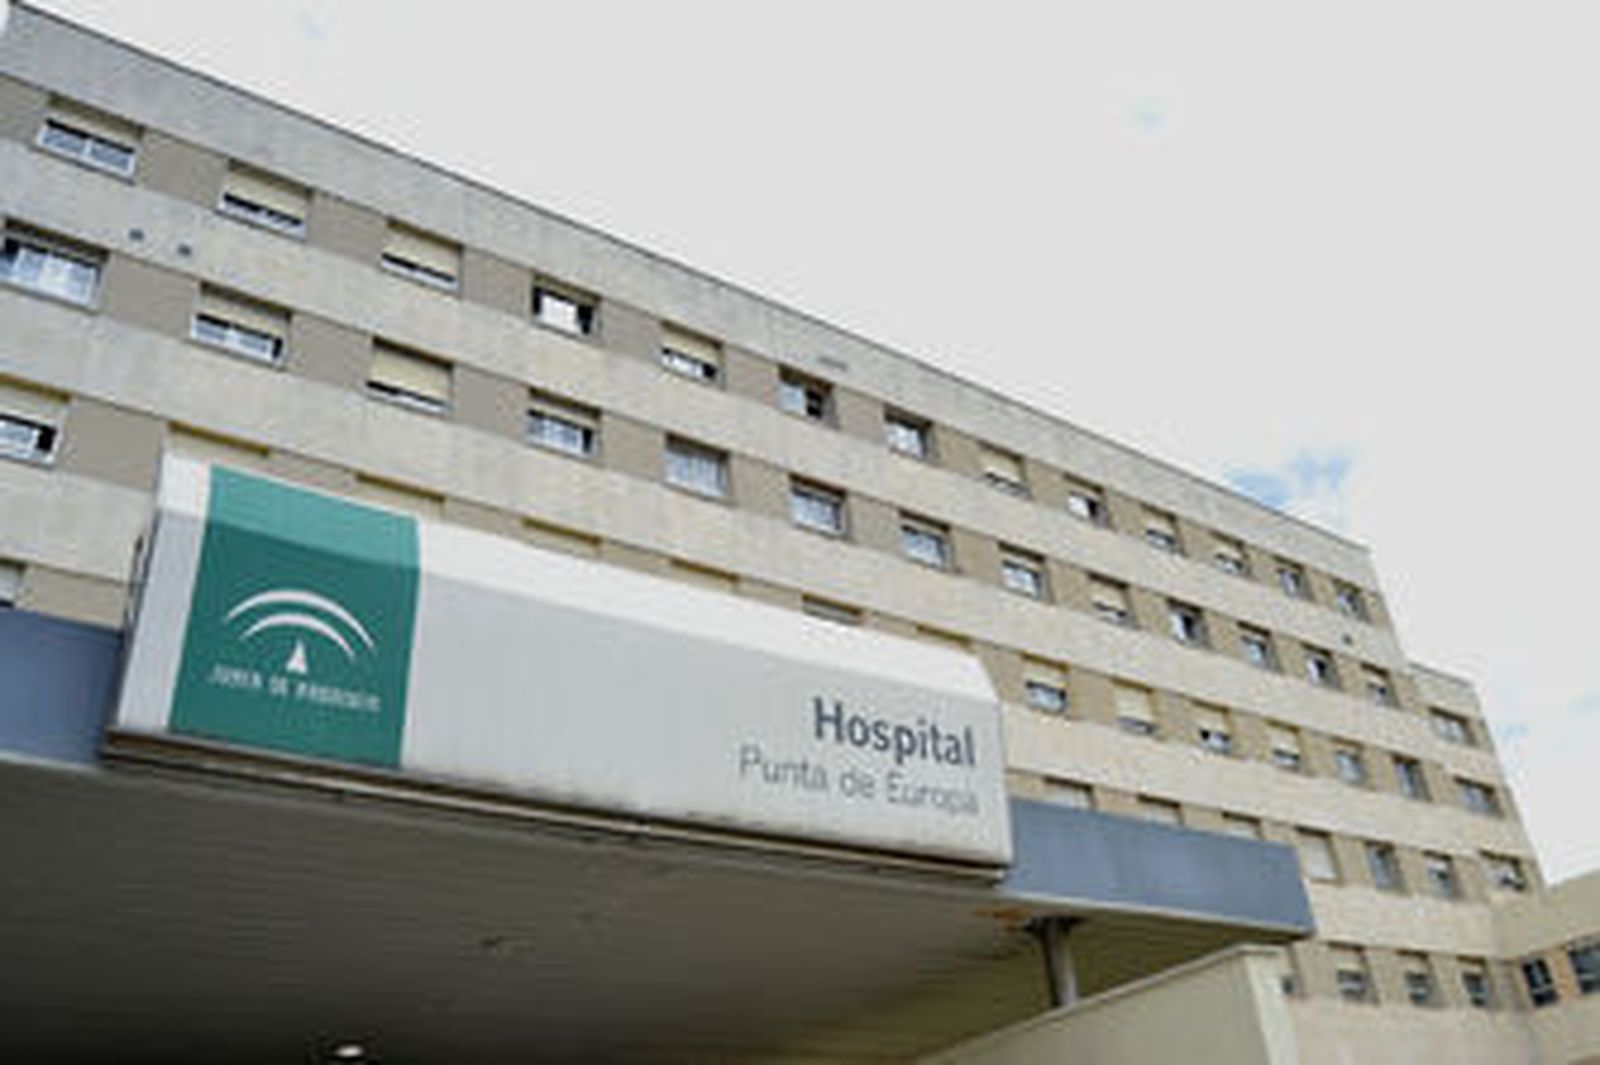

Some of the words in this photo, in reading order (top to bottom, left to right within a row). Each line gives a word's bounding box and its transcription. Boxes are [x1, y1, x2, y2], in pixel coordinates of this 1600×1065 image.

[814, 696, 976, 767] Hospital
[739, 745, 828, 791] Punta
[841, 769, 875, 798] de
[887, 770, 978, 816] Europa
